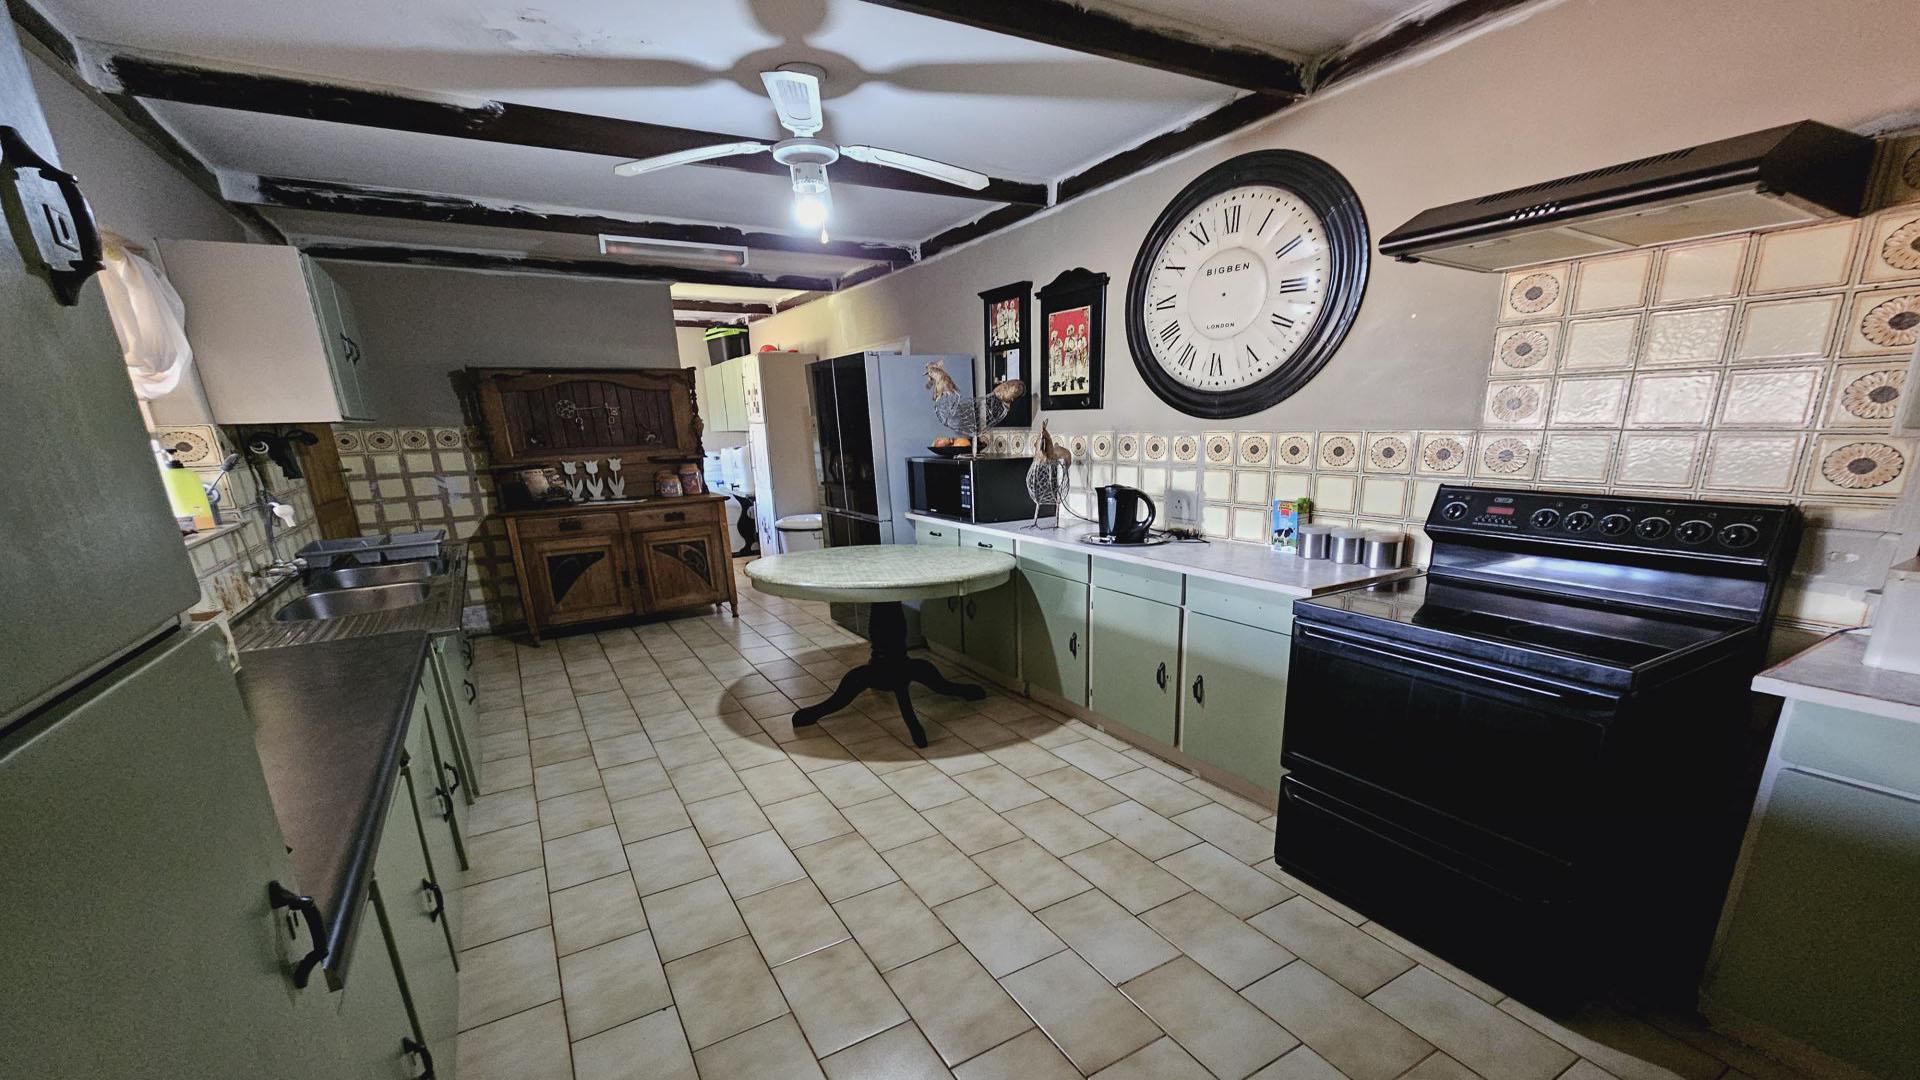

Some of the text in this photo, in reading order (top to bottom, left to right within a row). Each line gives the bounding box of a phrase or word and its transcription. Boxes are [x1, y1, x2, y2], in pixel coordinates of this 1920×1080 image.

[1223, 204, 1241, 235] XII
[1275, 235, 1303, 259] II
[1280, 277, 1308, 294] III
[1206, 322, 1235, 330] LONDON
